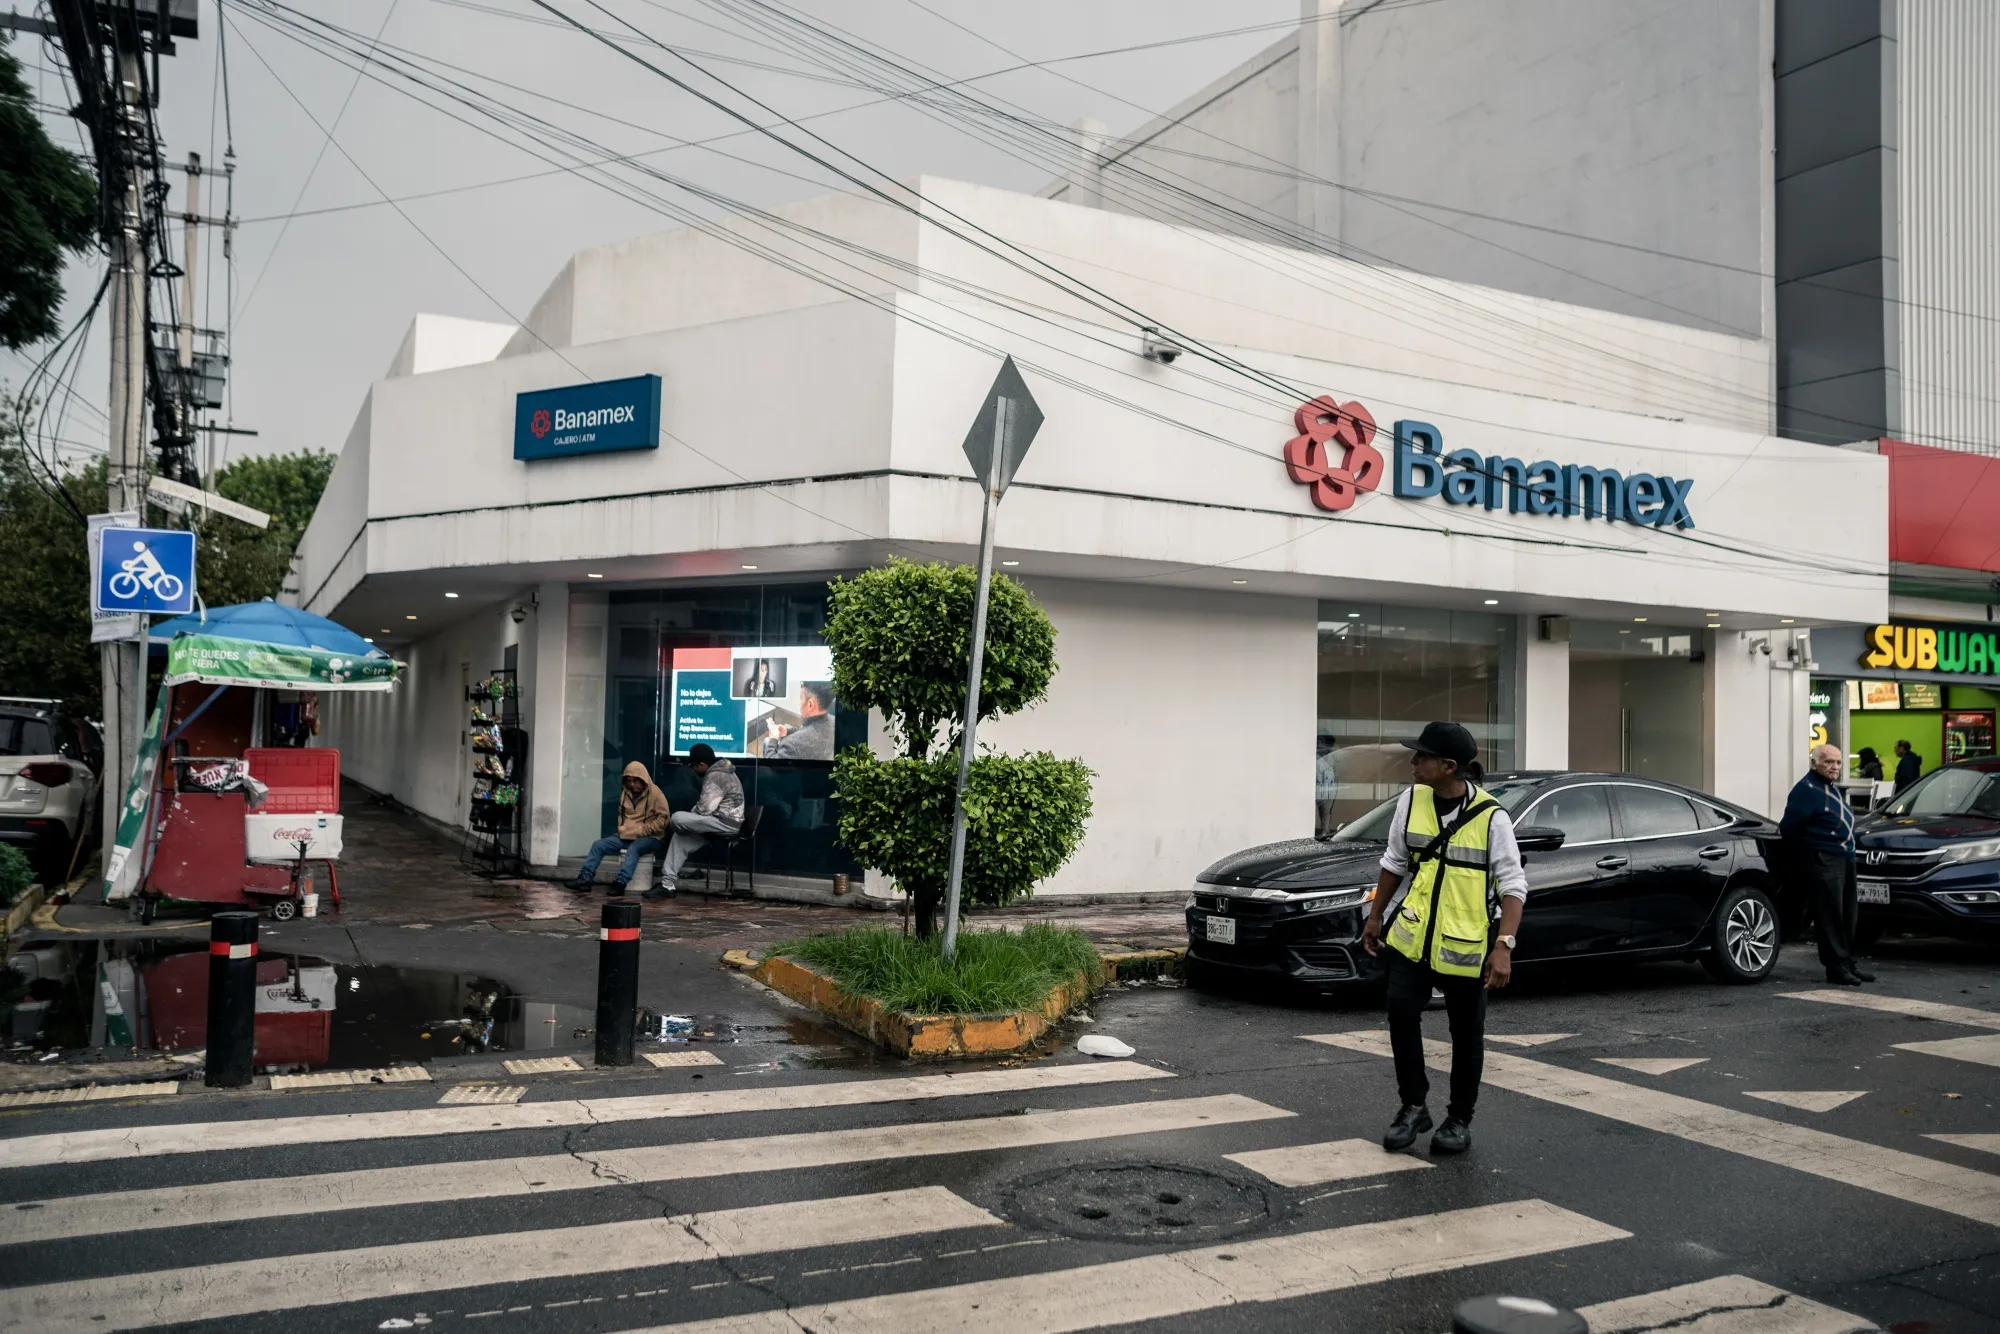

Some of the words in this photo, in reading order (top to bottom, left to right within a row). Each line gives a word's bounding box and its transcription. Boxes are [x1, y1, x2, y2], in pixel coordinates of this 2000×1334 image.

[554, 405, 635, 431] Banamex
[554, 435, 578, 446] CAJERO
[582, 433, 596, 443] ATM
[1393, 419, 1696, 530] Banamex
[174, 650, 187, 660] NO
[200, 649, 240, 661] QUEDES
[1866, 624, 2000, 674] SUBWAY
[680, 689, 689, 697] No
[695, 689, 712, 698] dejes
[1810, 692, 1831, 704] ierto
[680, 699, 693, 707] para
[273, 827, 313, 841] Coca-Cola
